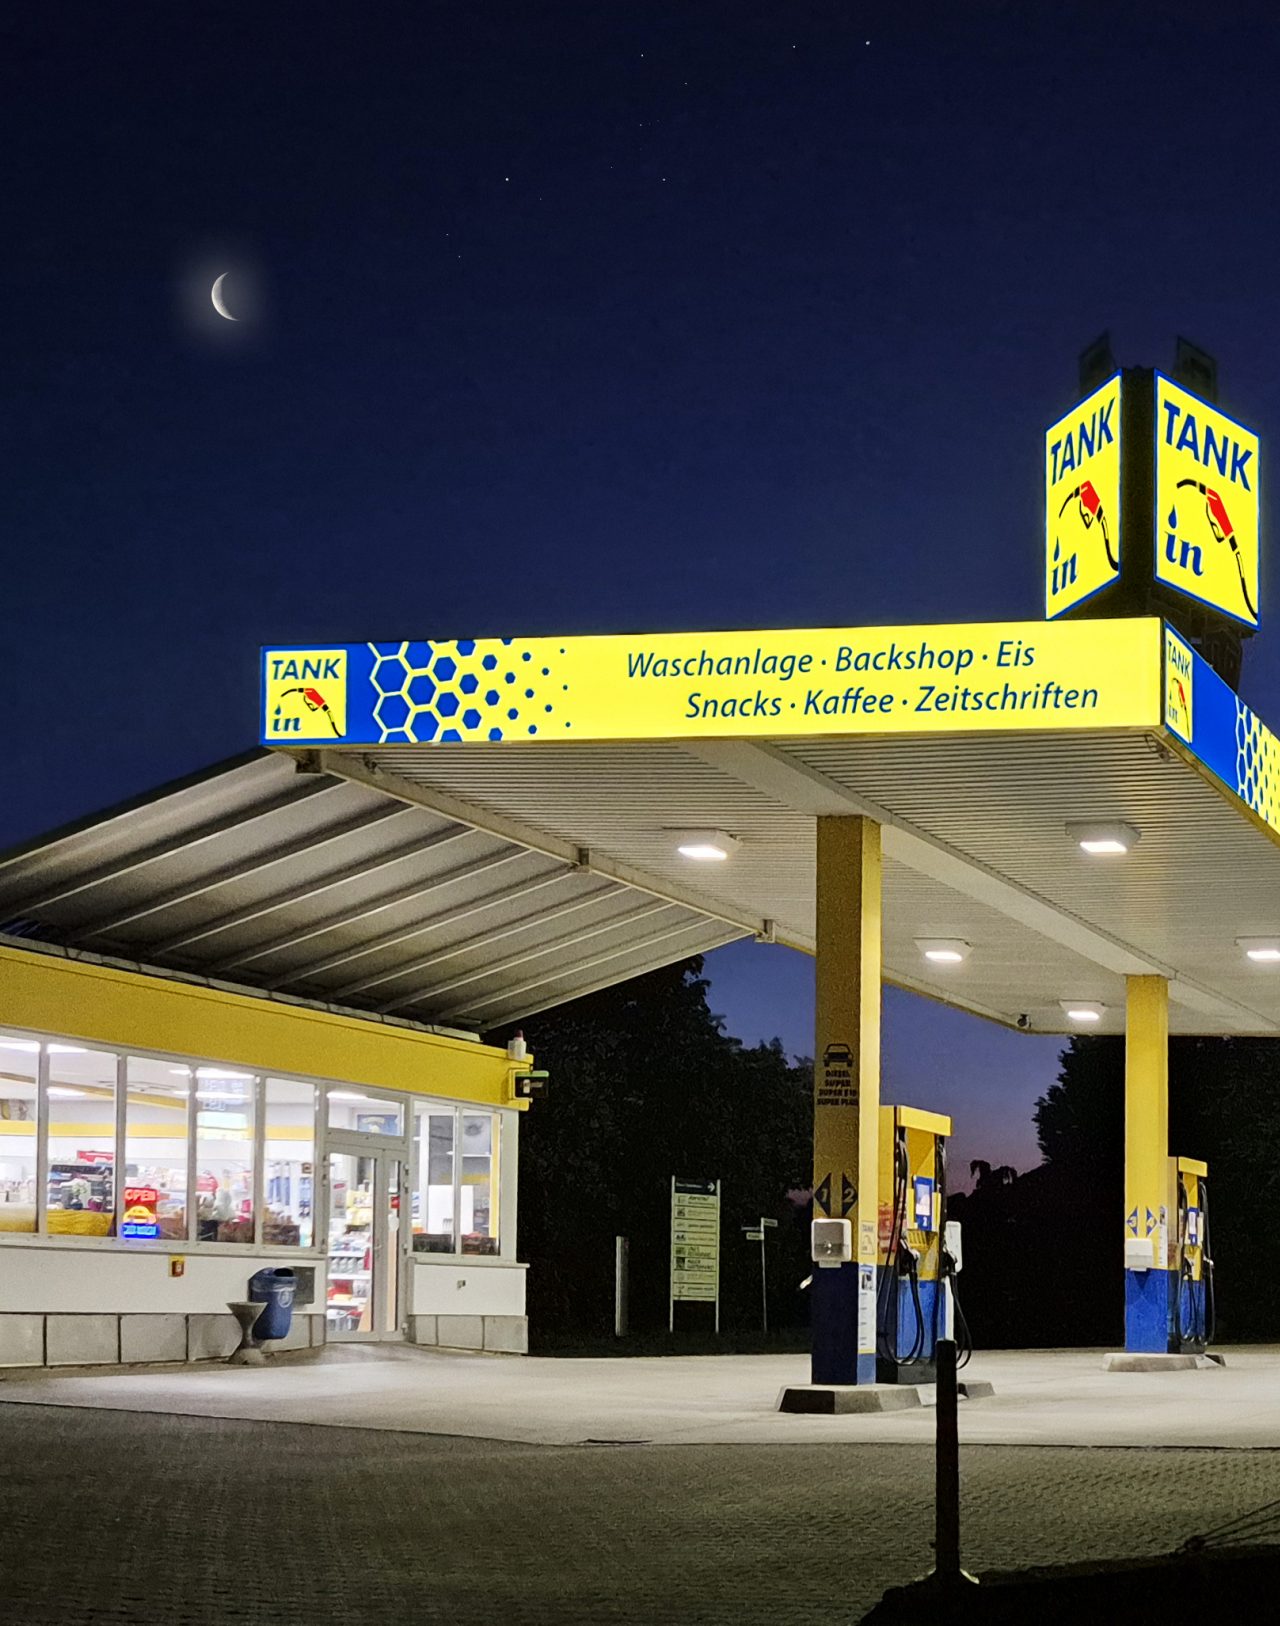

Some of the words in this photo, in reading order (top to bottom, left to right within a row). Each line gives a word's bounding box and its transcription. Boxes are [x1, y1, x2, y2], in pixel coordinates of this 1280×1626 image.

[1051, 397, 1115, 486] TANK
[1164, 399, 1253, 492] TANK
[1164, 504, 1203, 577] in
[1052, 536, 1077, 596] in
[272, 658, 341, 681] TANK
[628, 647, 814, 681] Waschanlage
[835, 641, 974, 676] Backshop
[996, 640, 1035, 667] Eis
[1168, 640, 1190, 680] TANK
[272, 706, 301, 732] in
[685, 689, 782, 719] Snacks
[803, 686, 894, 716] Kaffee
[914, 681, 1098, 712] Zeitschriften
[821, 1188, 828, 1202] 1
[843, 1189, 855, 1202] 2
